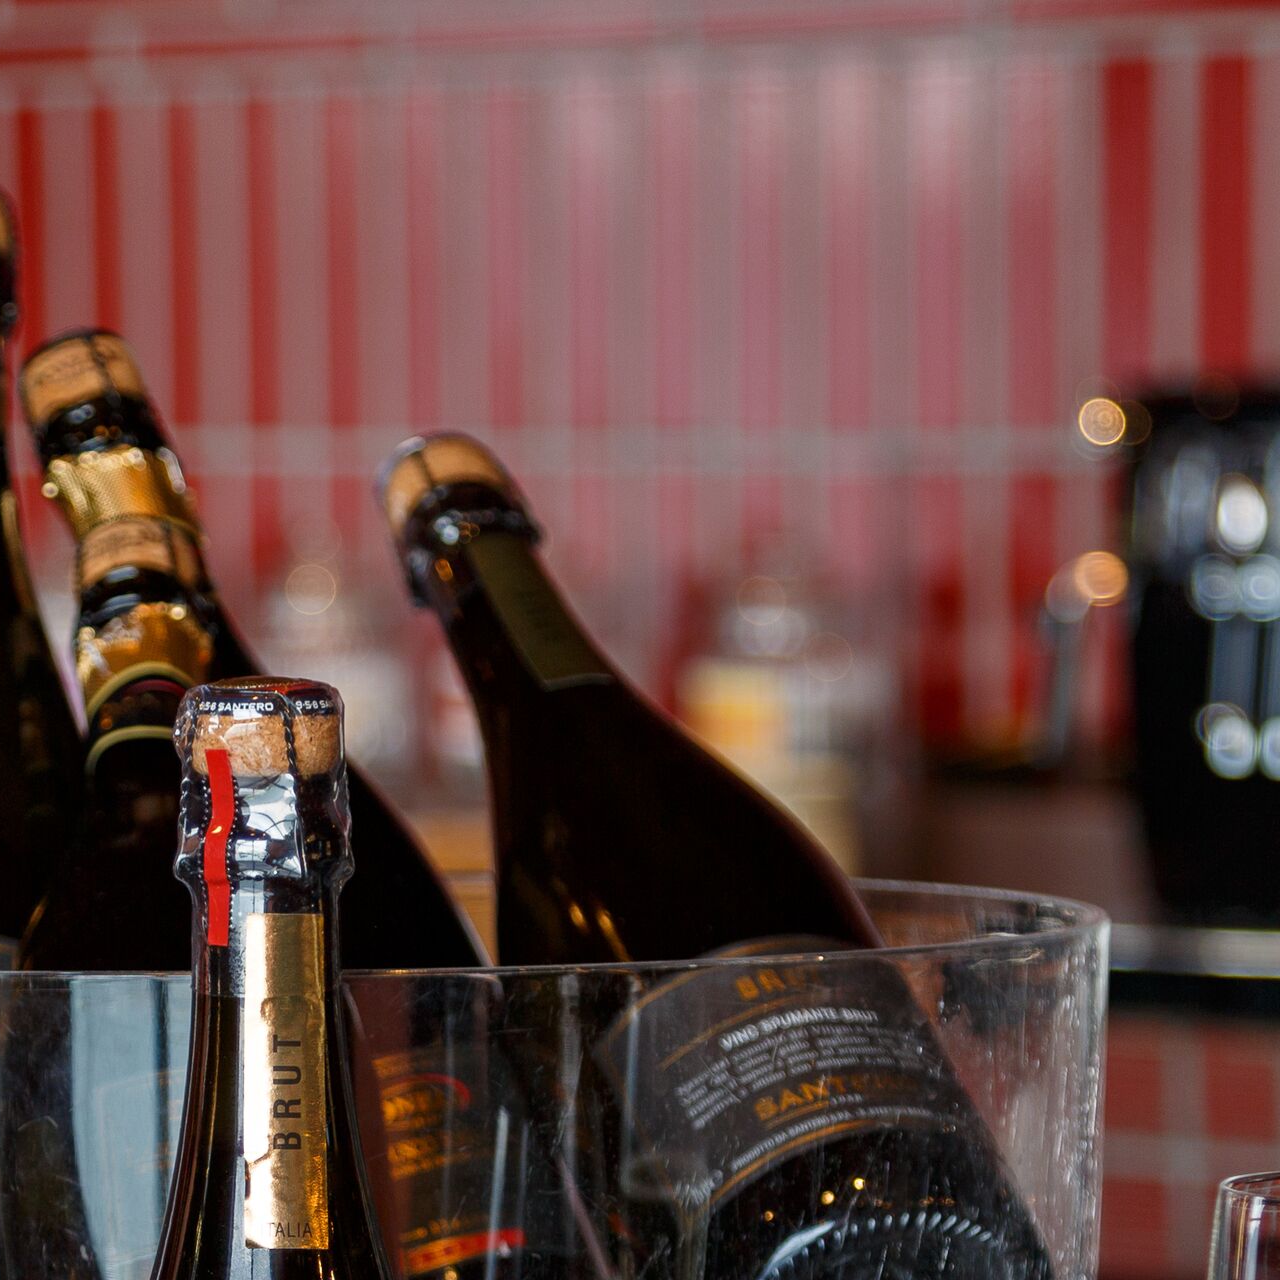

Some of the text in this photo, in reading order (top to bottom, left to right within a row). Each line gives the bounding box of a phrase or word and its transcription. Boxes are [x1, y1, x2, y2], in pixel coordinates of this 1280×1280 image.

[218, 701, 274, 712] SANTERO
[272, 1034, 302, 1150] BRUT
[261, 1222, 313, 1238] TALIA
